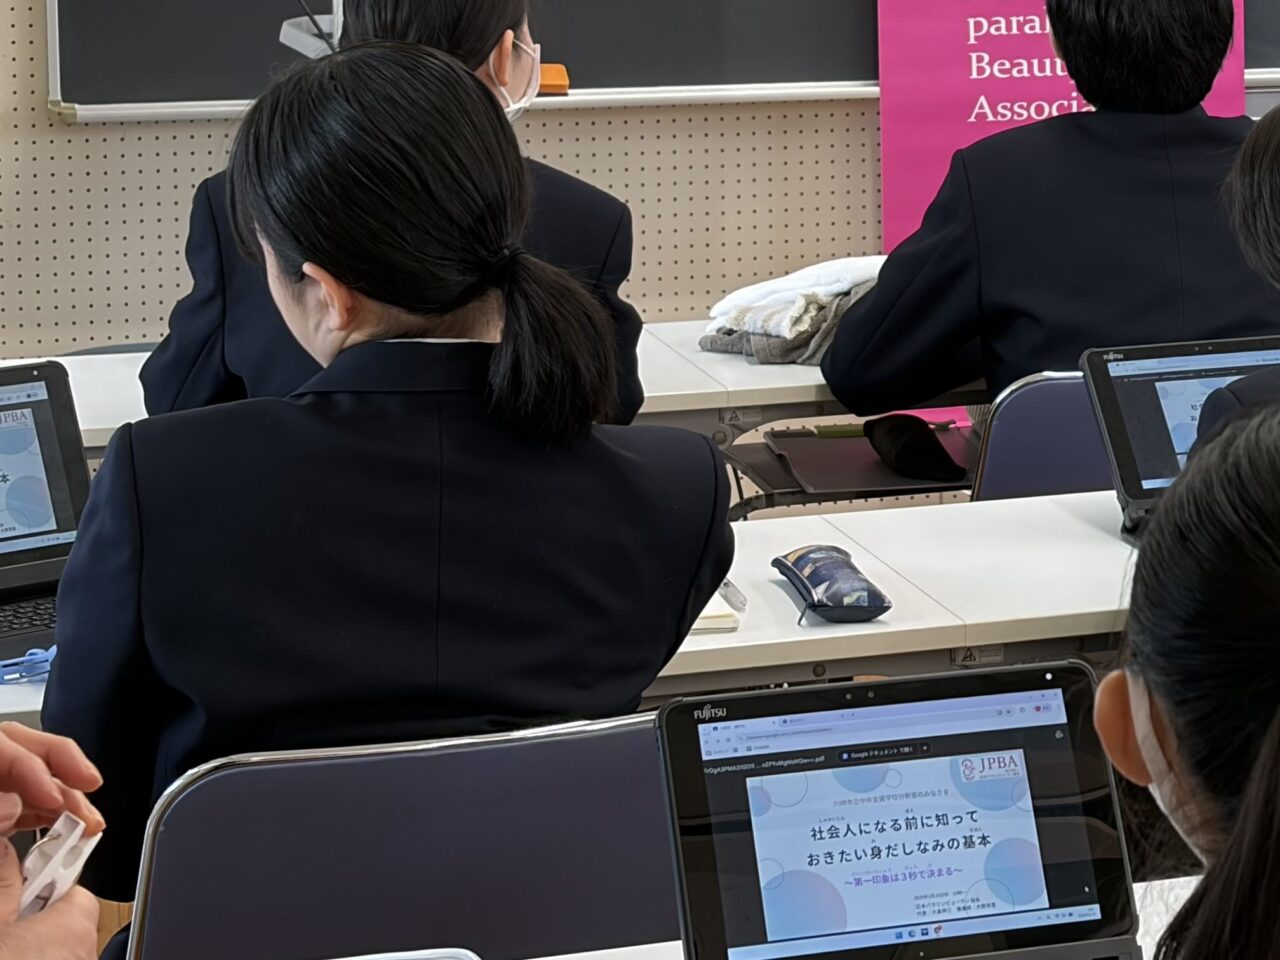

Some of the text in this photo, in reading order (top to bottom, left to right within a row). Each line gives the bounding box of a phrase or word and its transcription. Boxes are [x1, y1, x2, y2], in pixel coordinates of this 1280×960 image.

[969, 52, 1075, 85] Beaut
[694, 704, 727, 720] FUJITSU
[979, 754, 1019, 773] JPBA
[810, 810, 979, 842] 社会人になる前に知って
[807, 833, 992, 867] おきたい身だしなみの基本
